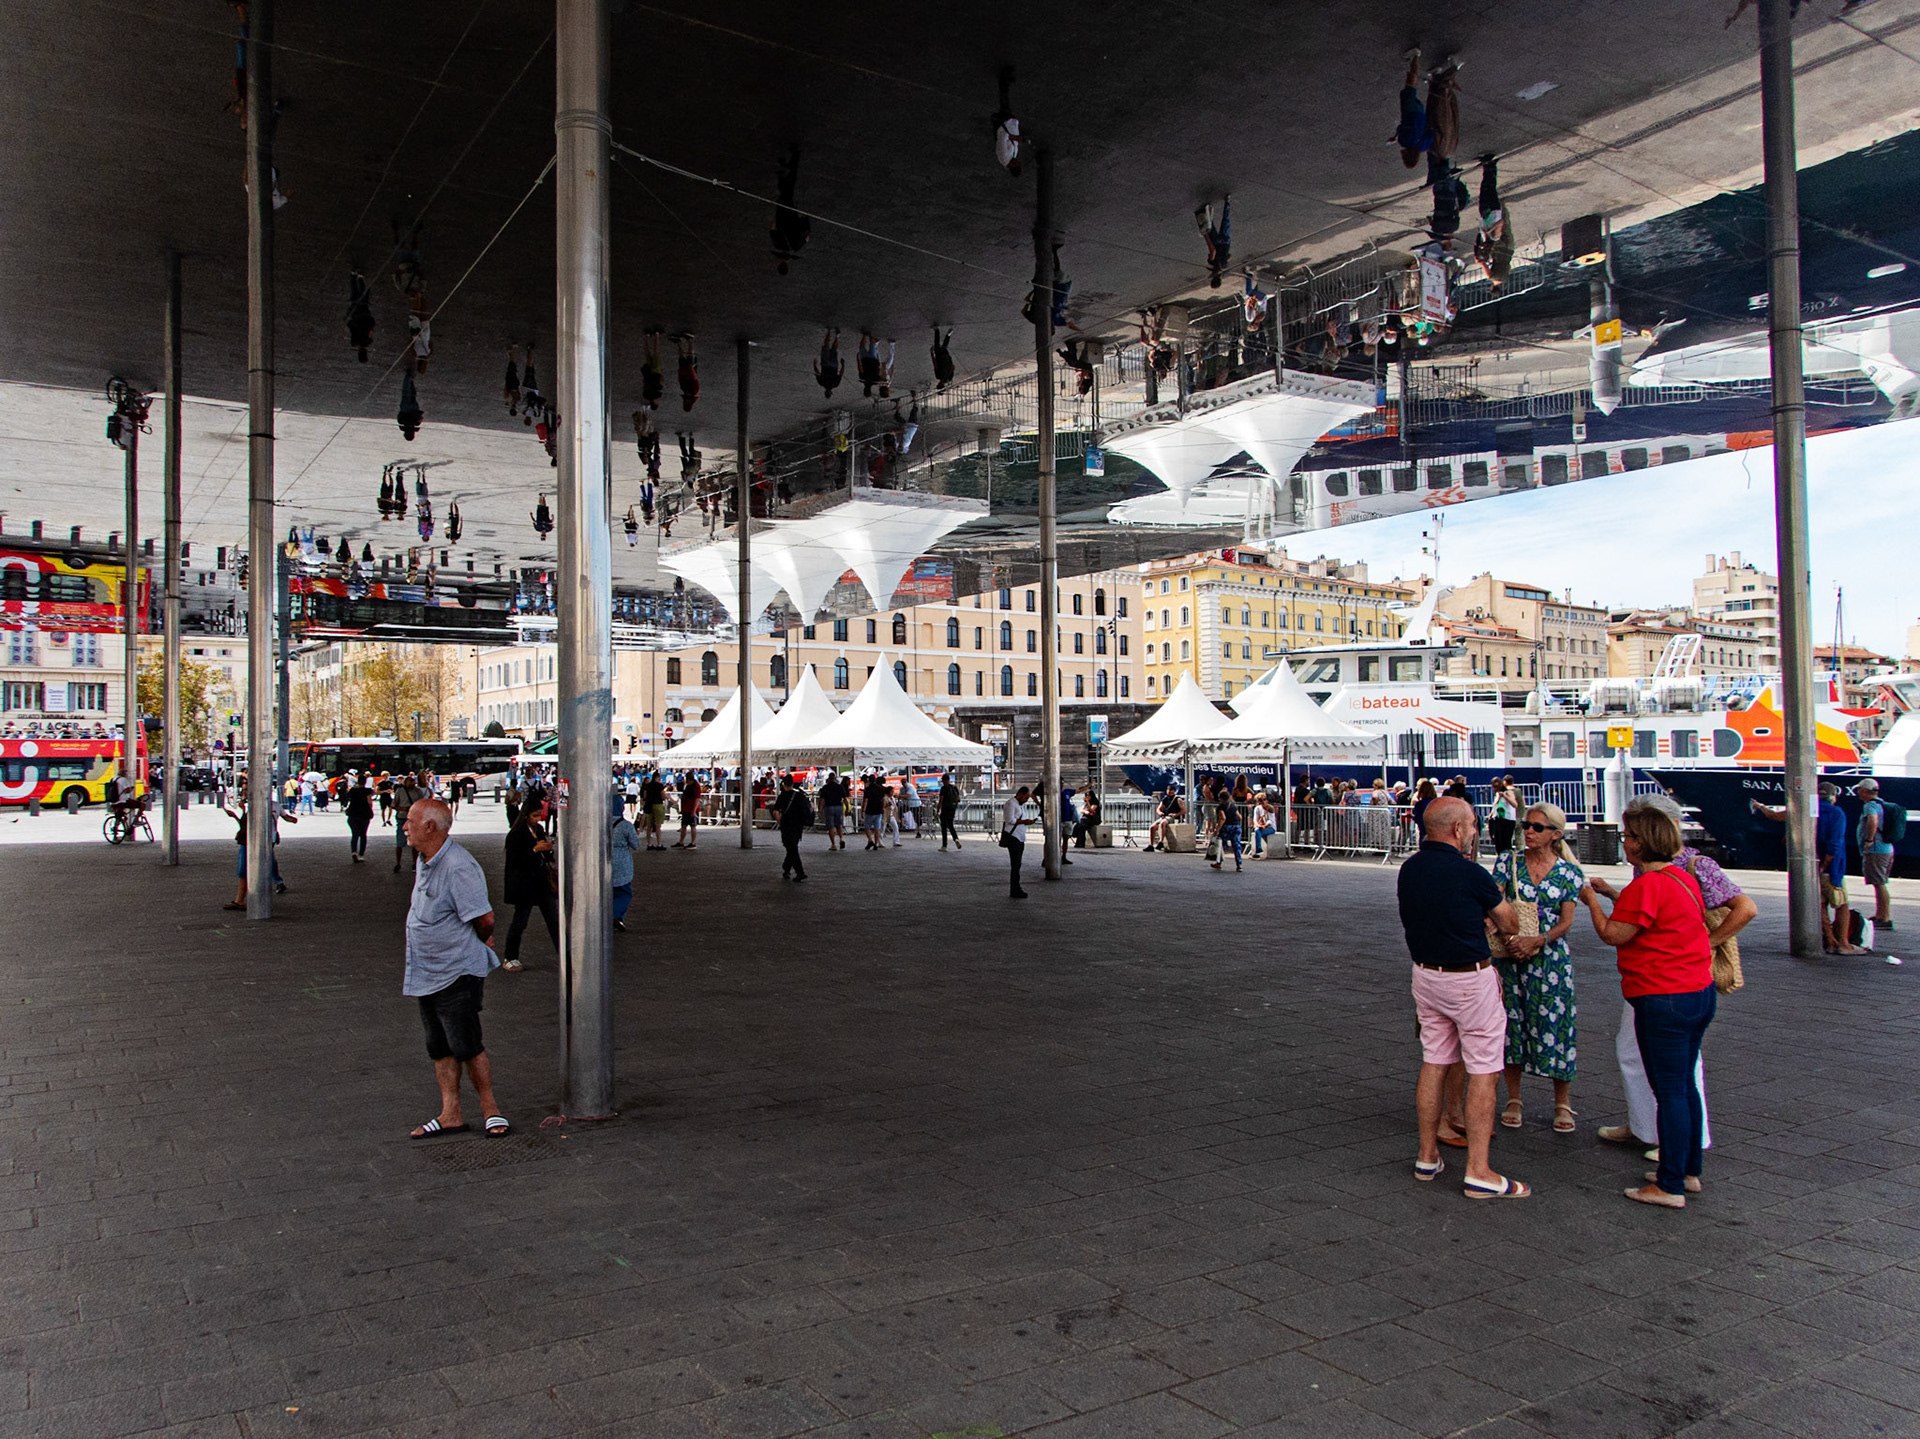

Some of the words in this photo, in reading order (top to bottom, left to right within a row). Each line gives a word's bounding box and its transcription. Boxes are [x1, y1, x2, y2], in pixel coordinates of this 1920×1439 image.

[1349, 695, 1420, 710] lebateau
[1210, 759, 1274, 775] Esperandieu
[1742, 779, 1771, 790] SAN
